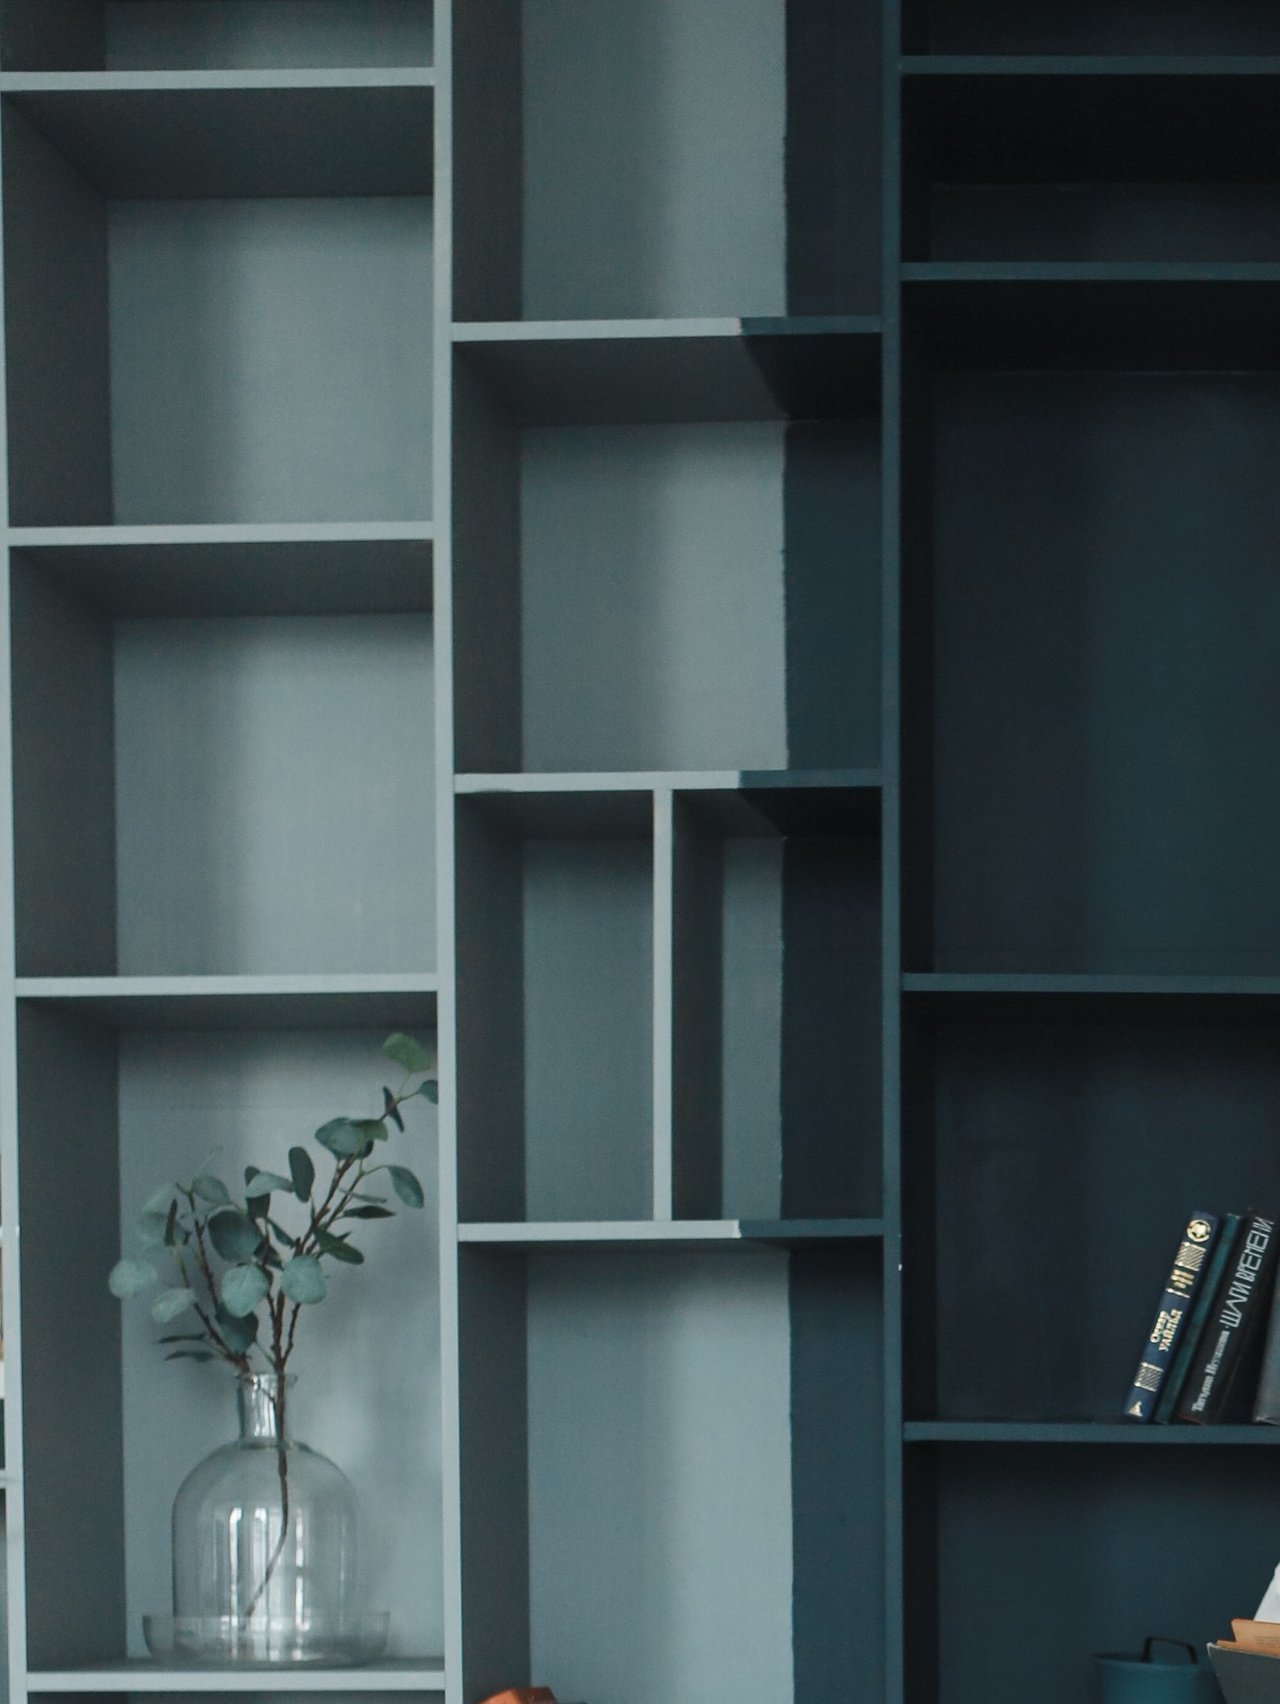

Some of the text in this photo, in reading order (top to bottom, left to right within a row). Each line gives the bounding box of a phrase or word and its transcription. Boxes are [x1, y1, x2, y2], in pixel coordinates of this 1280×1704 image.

[1235, 1216, 1275, 1283] ВРЕМЕНИ
[1150, 1310, 1170, 1344] Оскар
[1219, 1281, 1252, 1329] ШАГИ
